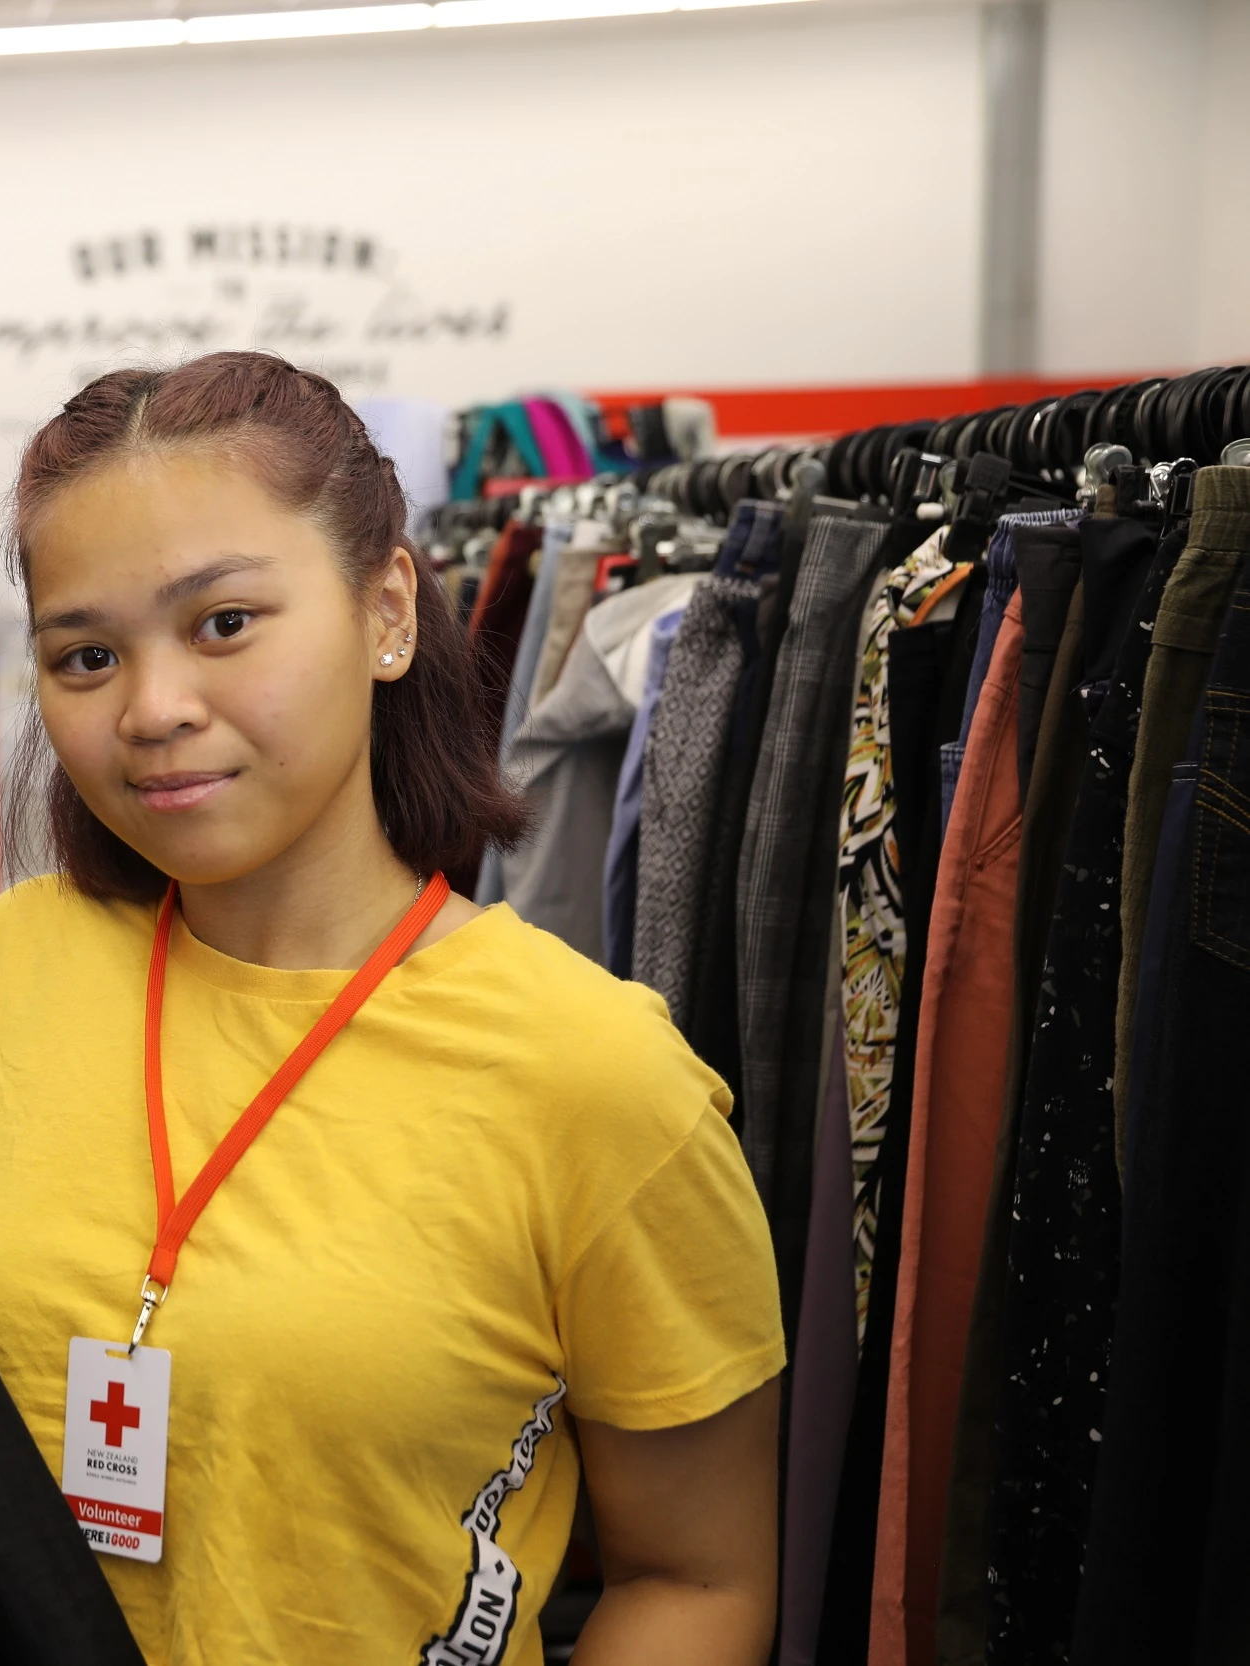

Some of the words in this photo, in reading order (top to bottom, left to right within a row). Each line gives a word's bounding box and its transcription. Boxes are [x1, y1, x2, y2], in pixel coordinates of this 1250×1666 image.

[187, 219, 382, 277] MISSION
[87, 1448, 104, 1458] NEW
[106, 1451, 139, 1464] ZEALAND
[87, 1457, 105, 1470] RED
[106, 1461, 138, 1477] CROSS
[78, 1500, 142, 1528] Volunteer
[111, 1532, 140, 1550] GOOD
[461, 1587, 506, 1662] NOT
